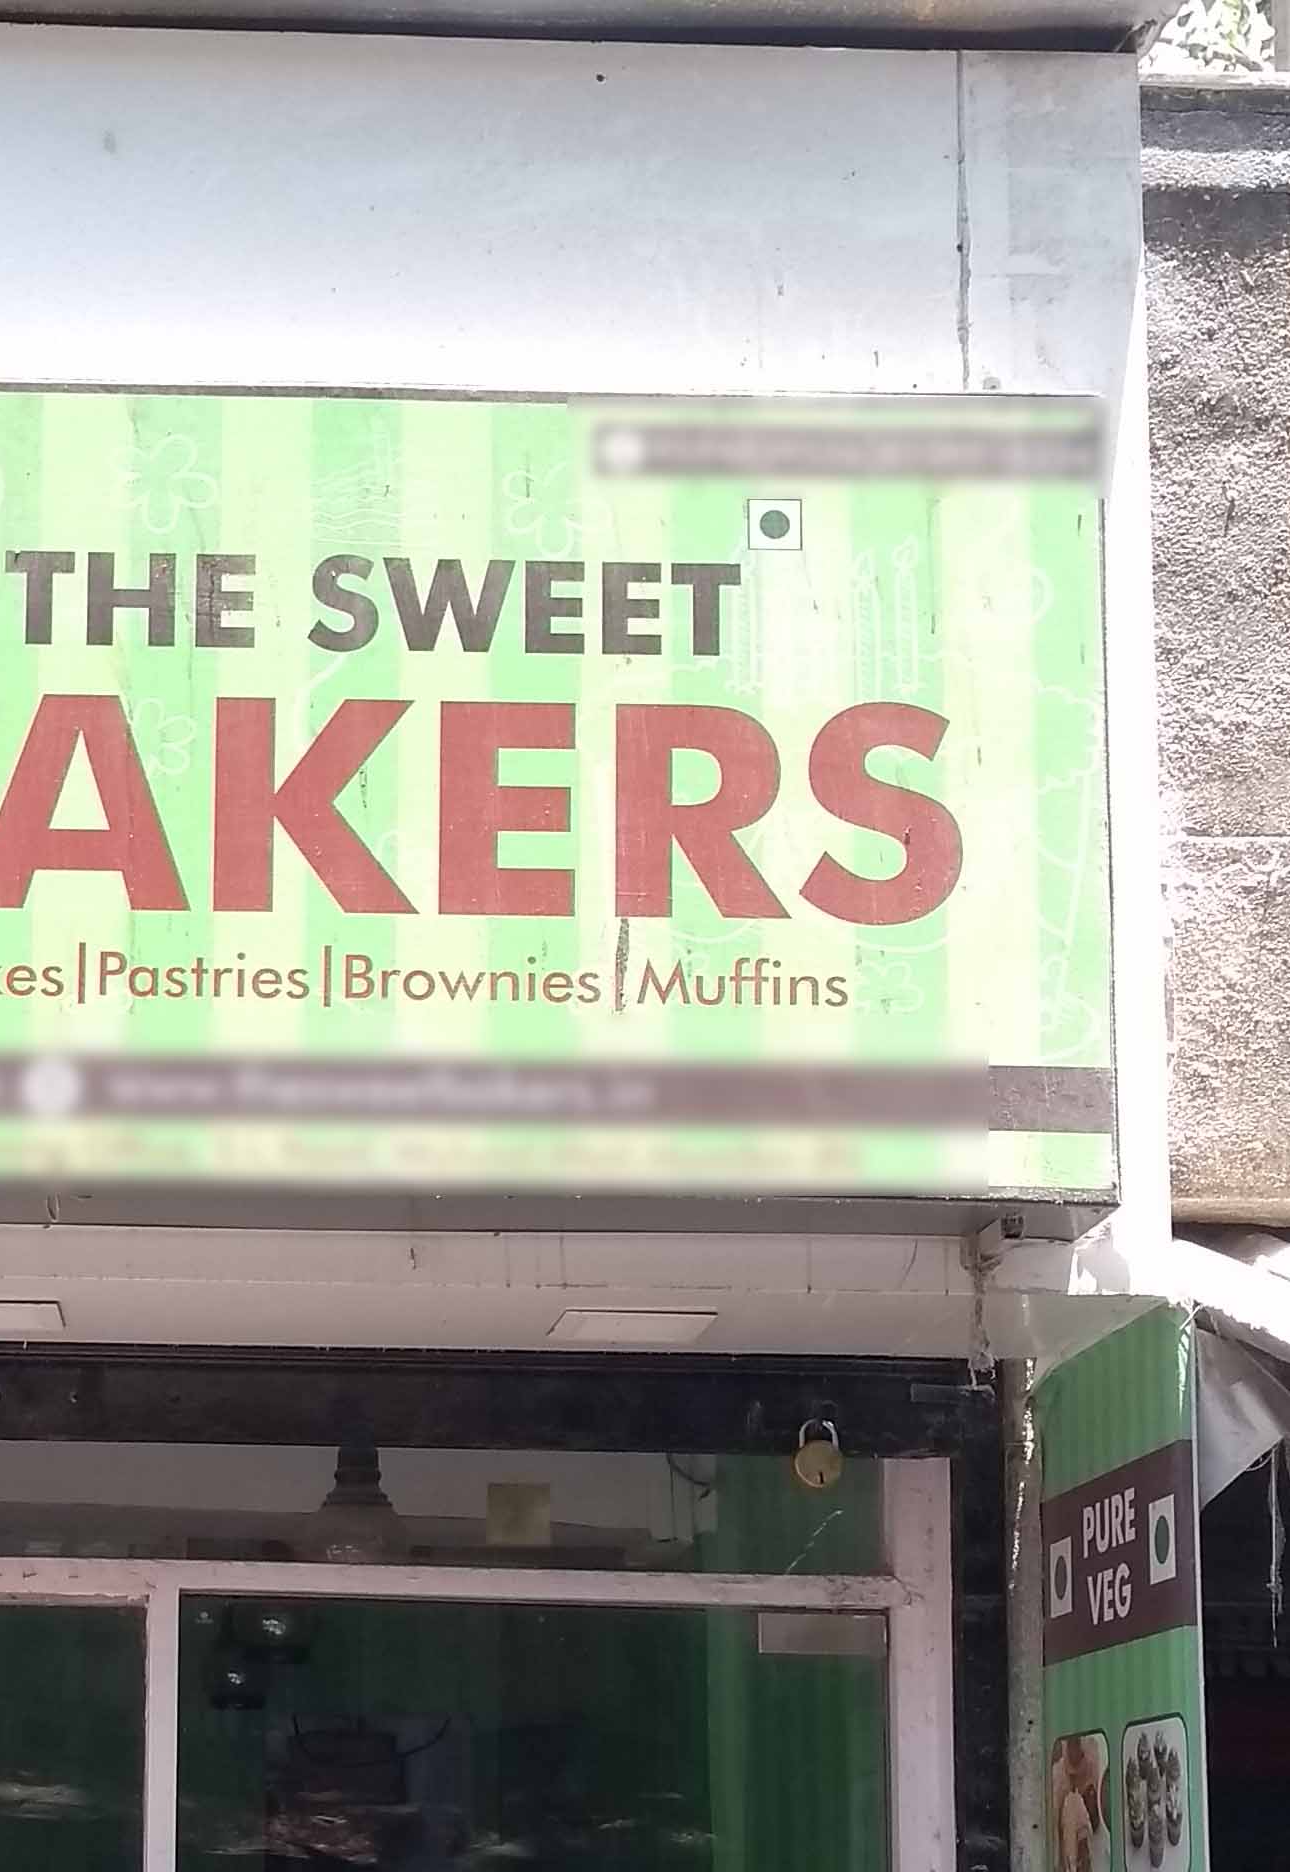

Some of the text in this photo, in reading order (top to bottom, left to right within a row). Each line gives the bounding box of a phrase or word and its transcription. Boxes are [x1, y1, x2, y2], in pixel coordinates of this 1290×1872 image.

[4, 549, 742, 657] THE SWEET
[1083, 1487, 1137, 1559] PURE
[1087, 1562, 1132, 1626] VEG
